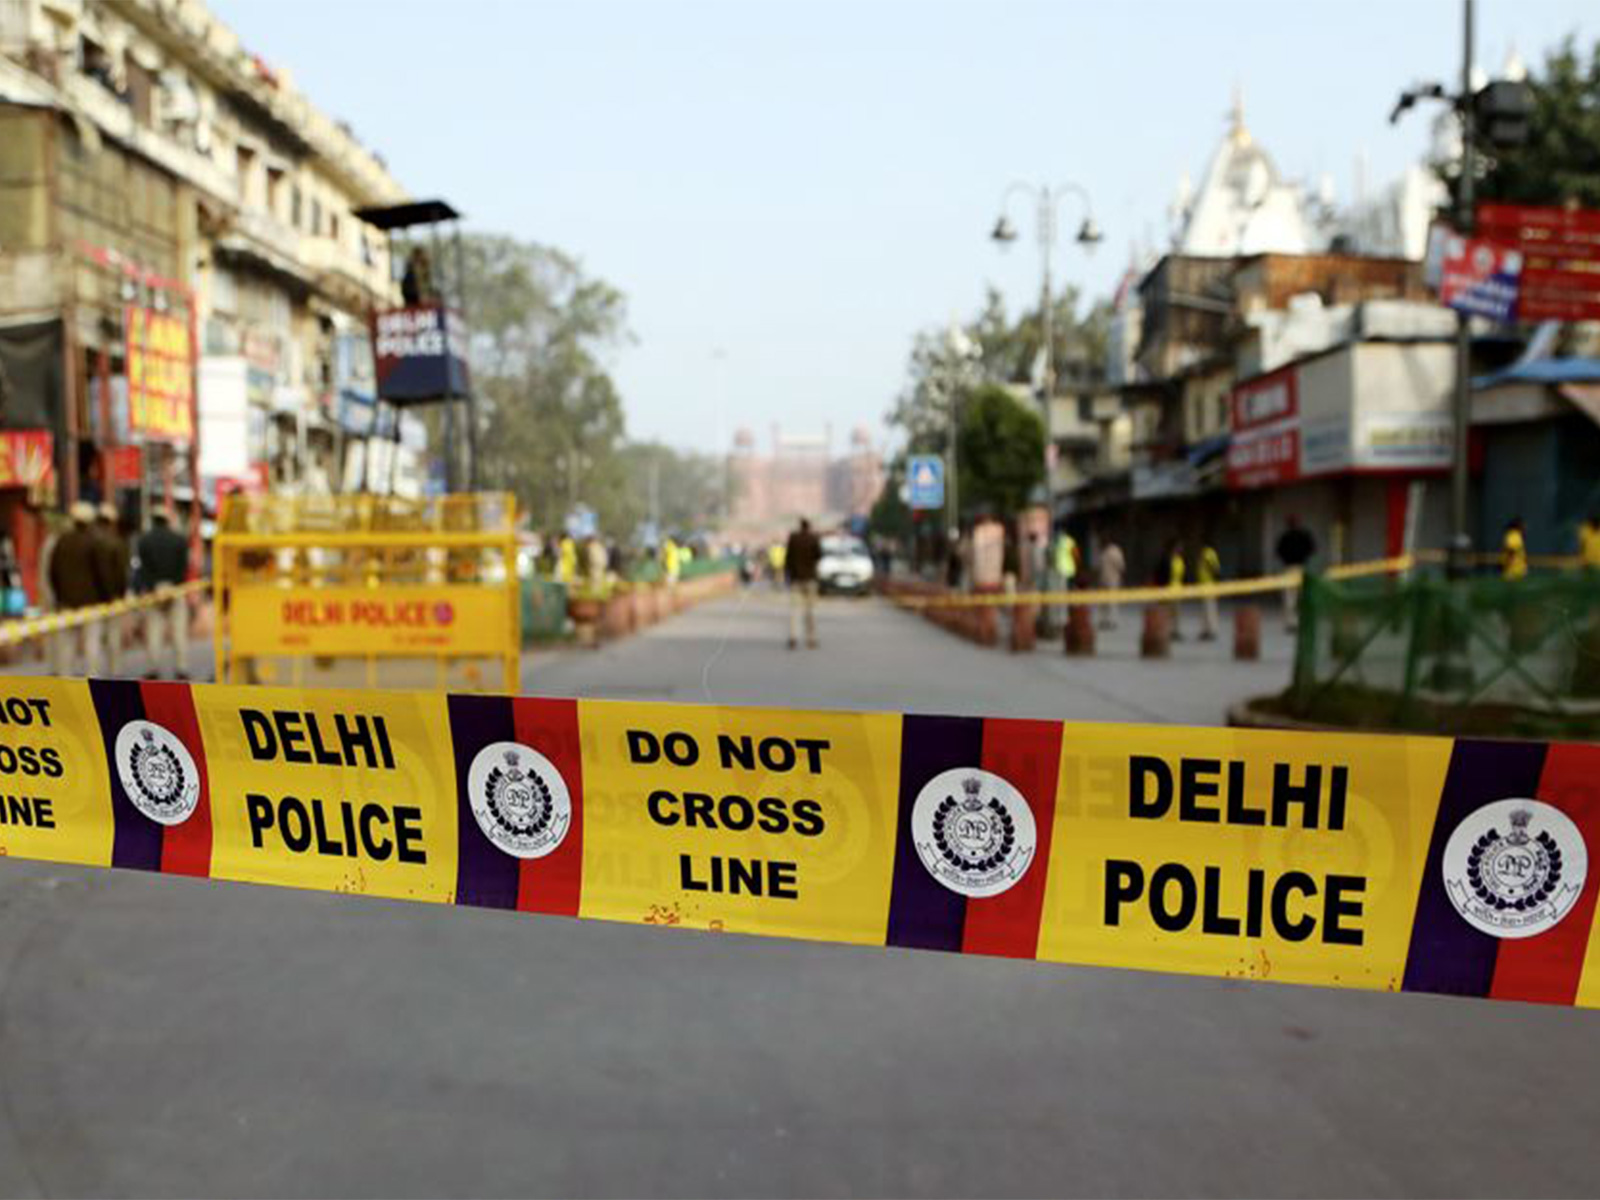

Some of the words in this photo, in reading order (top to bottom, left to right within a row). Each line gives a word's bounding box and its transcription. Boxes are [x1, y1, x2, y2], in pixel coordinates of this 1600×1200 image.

[0, 744, 64, 778] OSS
[239, 709, 396, 769] DELHI
[626, 730, 700, 767] DO
[717, 735, 831, 774] NOT
[0, 795, 56, 829] INE
[647, 790, 825, 836] CROSS
[1129, 755, 1349, 831] DELHI
[246, 794, 427, 865] POLICE
[680, 854, 798, 899] LINE
[1104, 859, 1366, 946] POLICE
